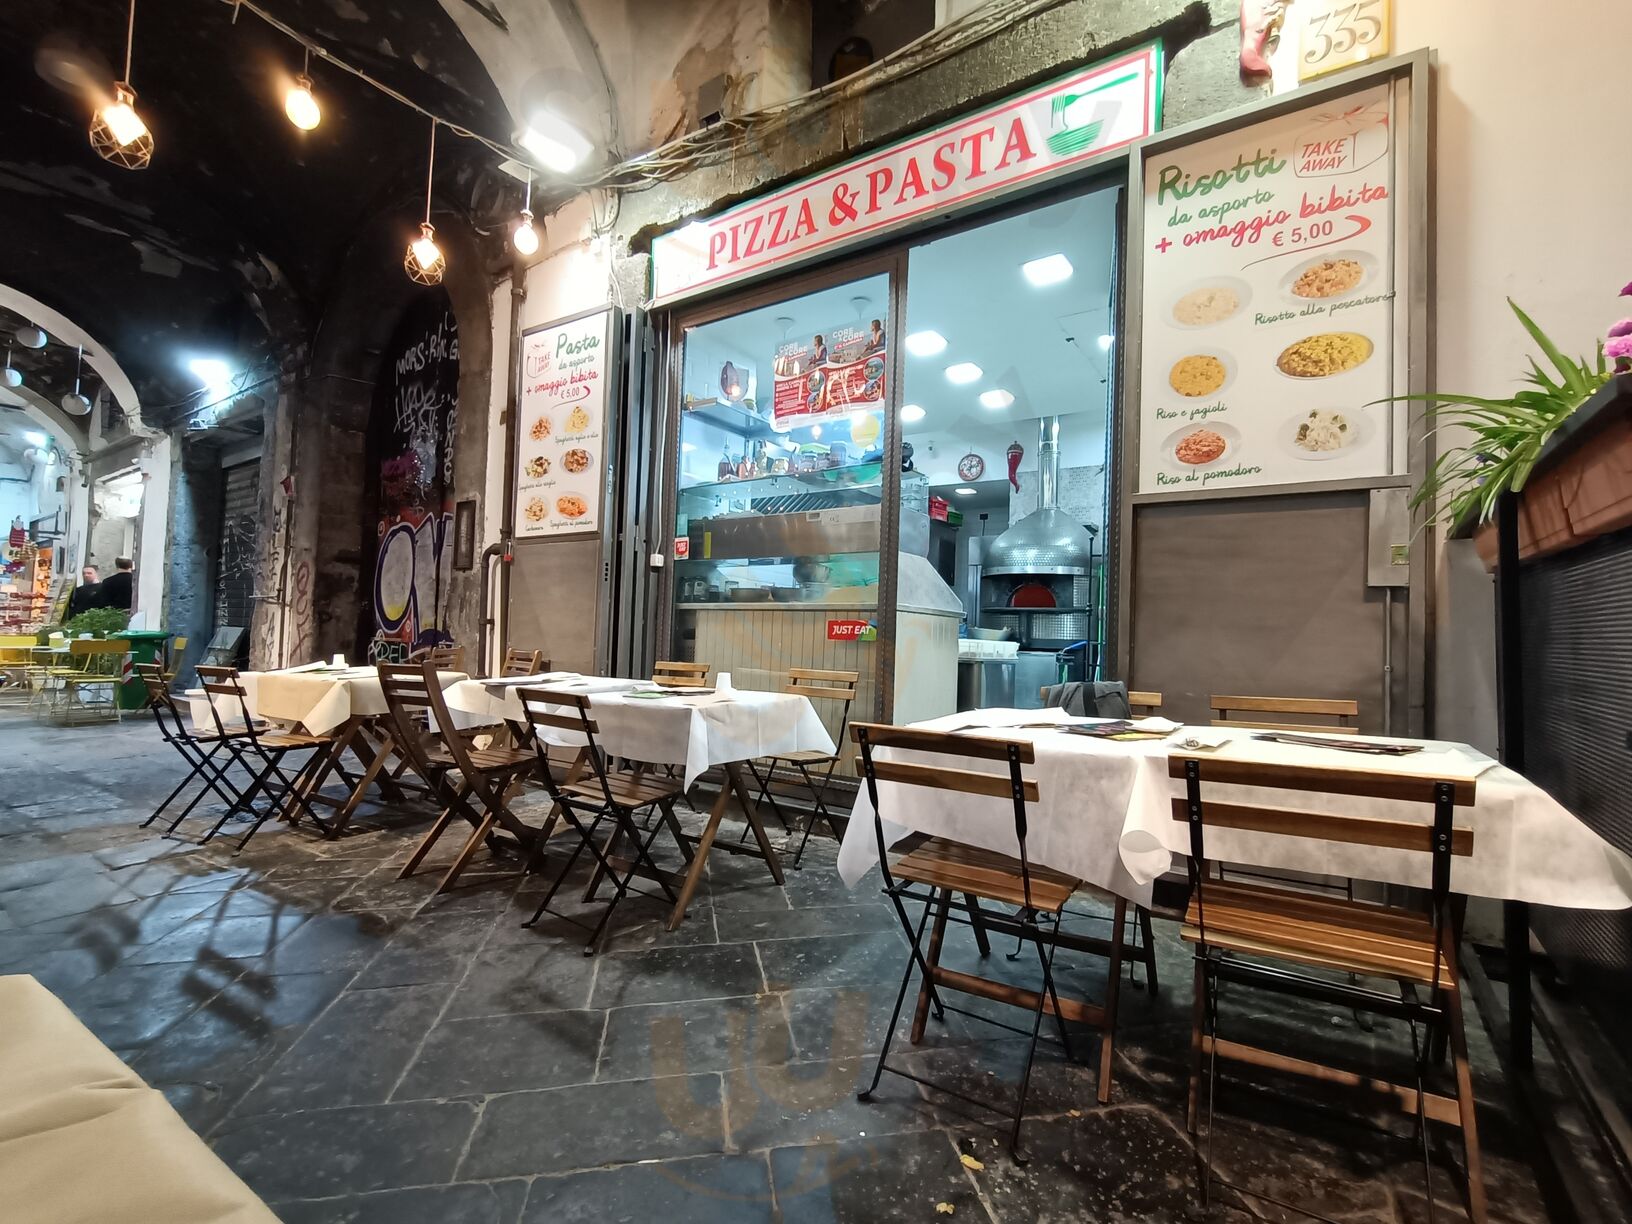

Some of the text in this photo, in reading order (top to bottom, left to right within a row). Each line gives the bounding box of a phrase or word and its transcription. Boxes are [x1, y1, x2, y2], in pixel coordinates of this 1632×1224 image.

[1304, 0, 1382, 64] 335
[1301, 137, 1348, 159] TAKE
[1299, 155, 1348, 174] AWAY
[1156, 148, 1287, 206] Risotti
[706, 197, 818, 271] PIZZA
[864, 116, 1038, 215] PASTA
[1155, 183, 1389, 253] + omaggio bibita
[1167, 188, 1275, 228] da asporto
[1291, 220, 1334, 244] 5,00
[1254, 312, 1297, 326] Risotto
[1299, 303, 1326, 317] alla
[555, 333, 601, 359] Pasta
[569, 367, 599, 385] bibita
[1156, 408, 1179, 420] Riso
[1156, 462, 1263, 486] Riso al pomodoro
[832, 625, 870, 635] JUST EAT
